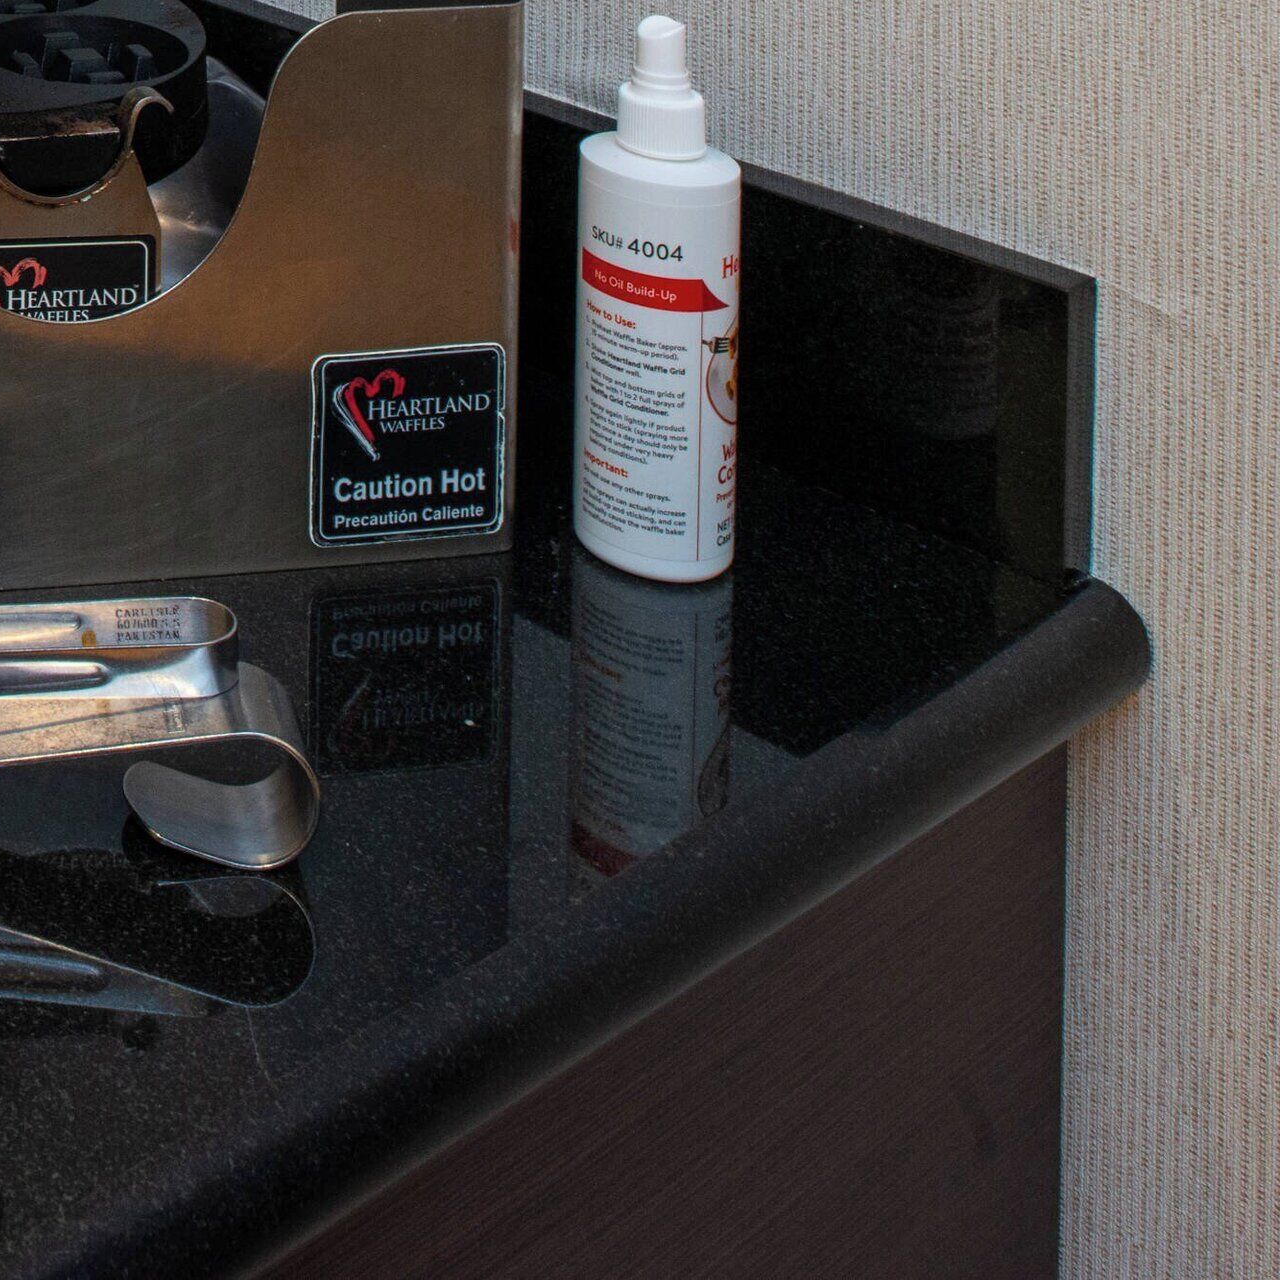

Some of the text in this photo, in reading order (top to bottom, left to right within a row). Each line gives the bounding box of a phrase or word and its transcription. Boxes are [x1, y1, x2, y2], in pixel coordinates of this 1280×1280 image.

[592, 225, 683, 262] SKU# 4004
[594, 269, 677, 303] No Oil Build-Up
[6, 287, 138, 310] HEARTLAND
[587, 300, 601, 315] How
[603, 310, 612, 320] to
[615, 314, 636, 329] Use:
[613, 331, 635, 342] Waffle
[636, 337, 657, 348] Baker
[608, 352, 685, 376] Heartland Waffle Grid
[614, 379, 626, 388] and
[628, 383, 655, 395] bottom
[656, 391, 675, 400] grids
[368, 393, 490, 420] HEARTLAND
[624, 391, 632, 399] to
[639, 395, 651, 403] full
[652, 399, 675, 408] sprays
[625, 401, 669, 416] Conditioner.
[380, 417, 446, 434] WAFFLES
[616, 422, 632, 432] stick
[634, 428, 668, 441] (spraying
[624, 414, 685, 433] lightly product
[637, 438, 661, 449] should
[661, 443, 677, 452] only
[635, 448, 651, 457] very
[652, 451, 674, 460] heavy
[334, 468, 486, 502] Caution Hot
[624, 486, 671, 502] other sprays.
[422, 504, 484, 521] Caliente
[629, 502, 686, 518] actually increase
[627, 519, 685, 536] the waffle baker
[117, 630, 180, 641] PAKISTAN
